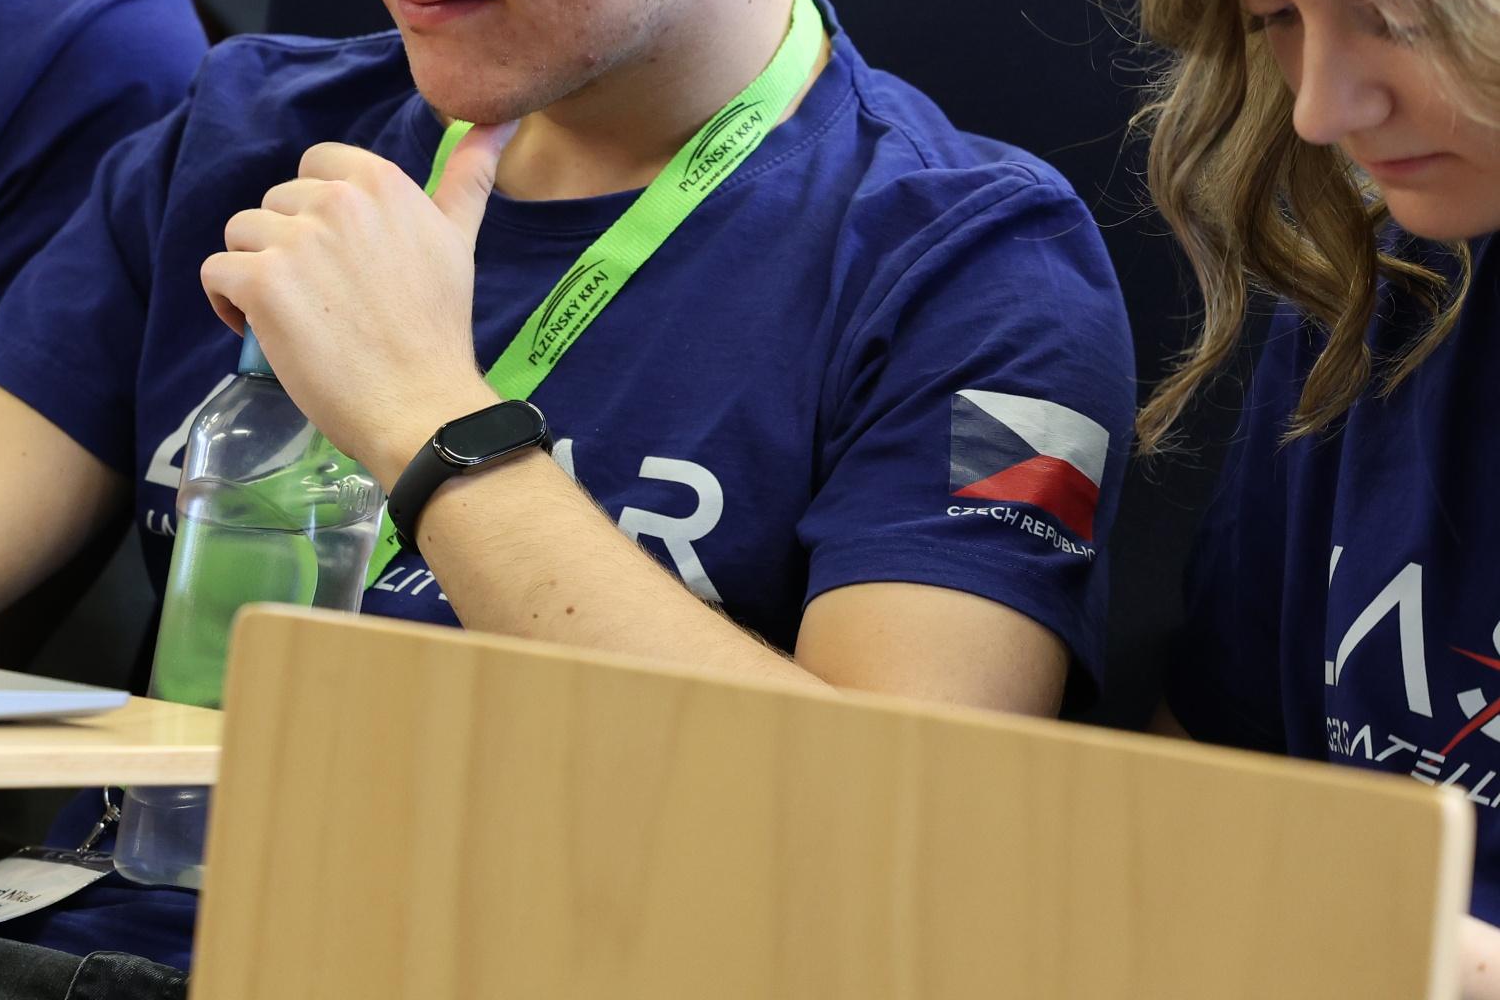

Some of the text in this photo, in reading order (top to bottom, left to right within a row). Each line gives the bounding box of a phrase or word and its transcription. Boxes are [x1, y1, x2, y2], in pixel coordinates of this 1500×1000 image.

[678, 110, 763, 192] PLZEŇSKÝ KRAJ
[527, 270, 609, 367] PLZEŇSKÝ KRAJ
[947, 506, 1020, 526] CZECH
